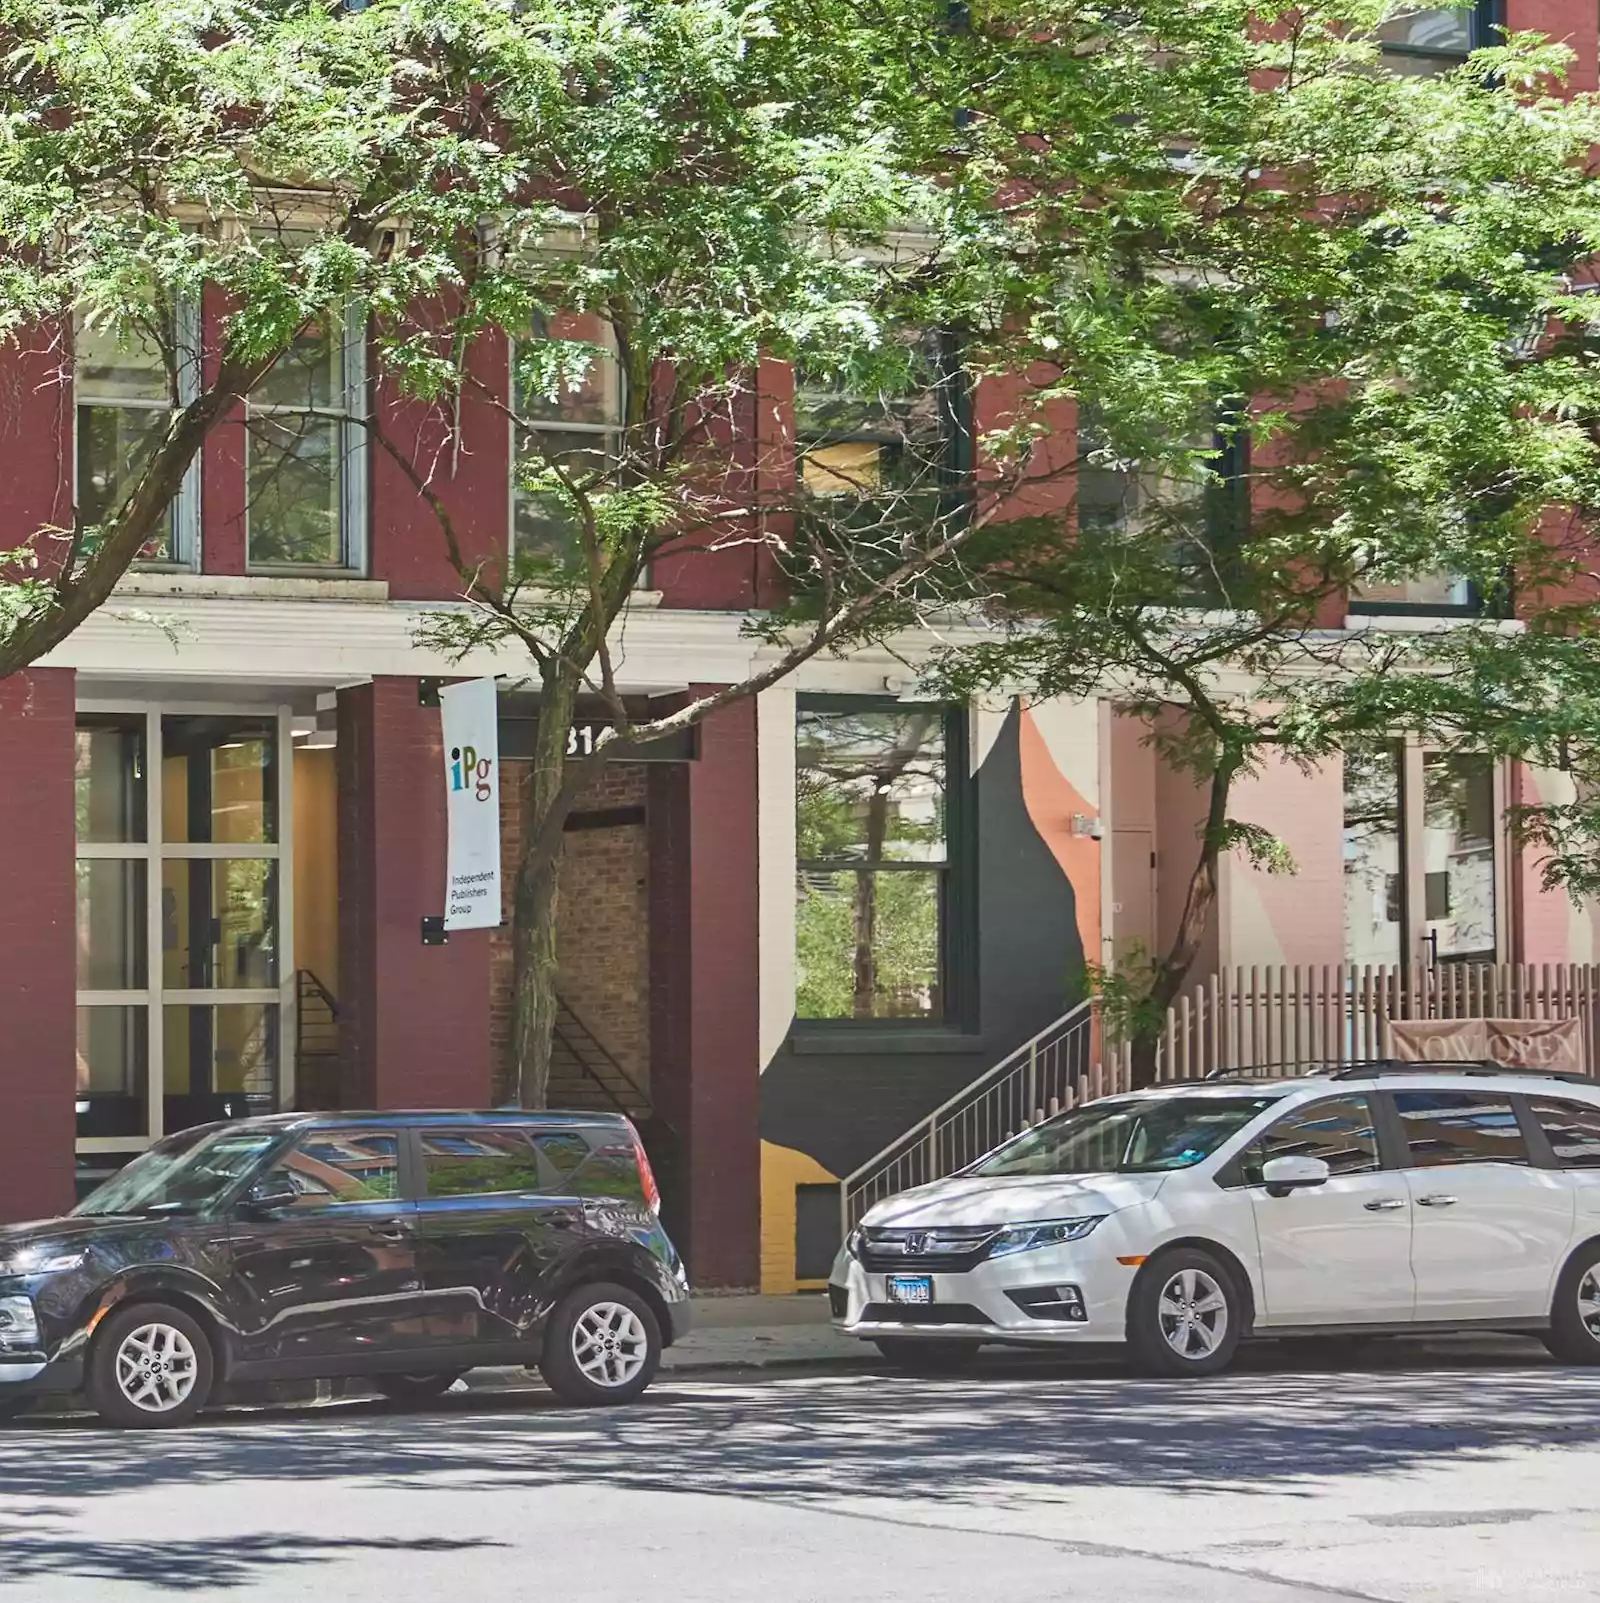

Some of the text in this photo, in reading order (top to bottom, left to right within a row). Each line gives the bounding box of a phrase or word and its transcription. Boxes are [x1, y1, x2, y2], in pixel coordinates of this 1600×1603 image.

[451, 745, 492, 802] iPg
[452, 871, 494, 886] Independent
[451, 888, 488, 901] Publishers
[450, 904, 472, 915] Group
[1395, 1032, 1577, 1065] NOW OPEN
